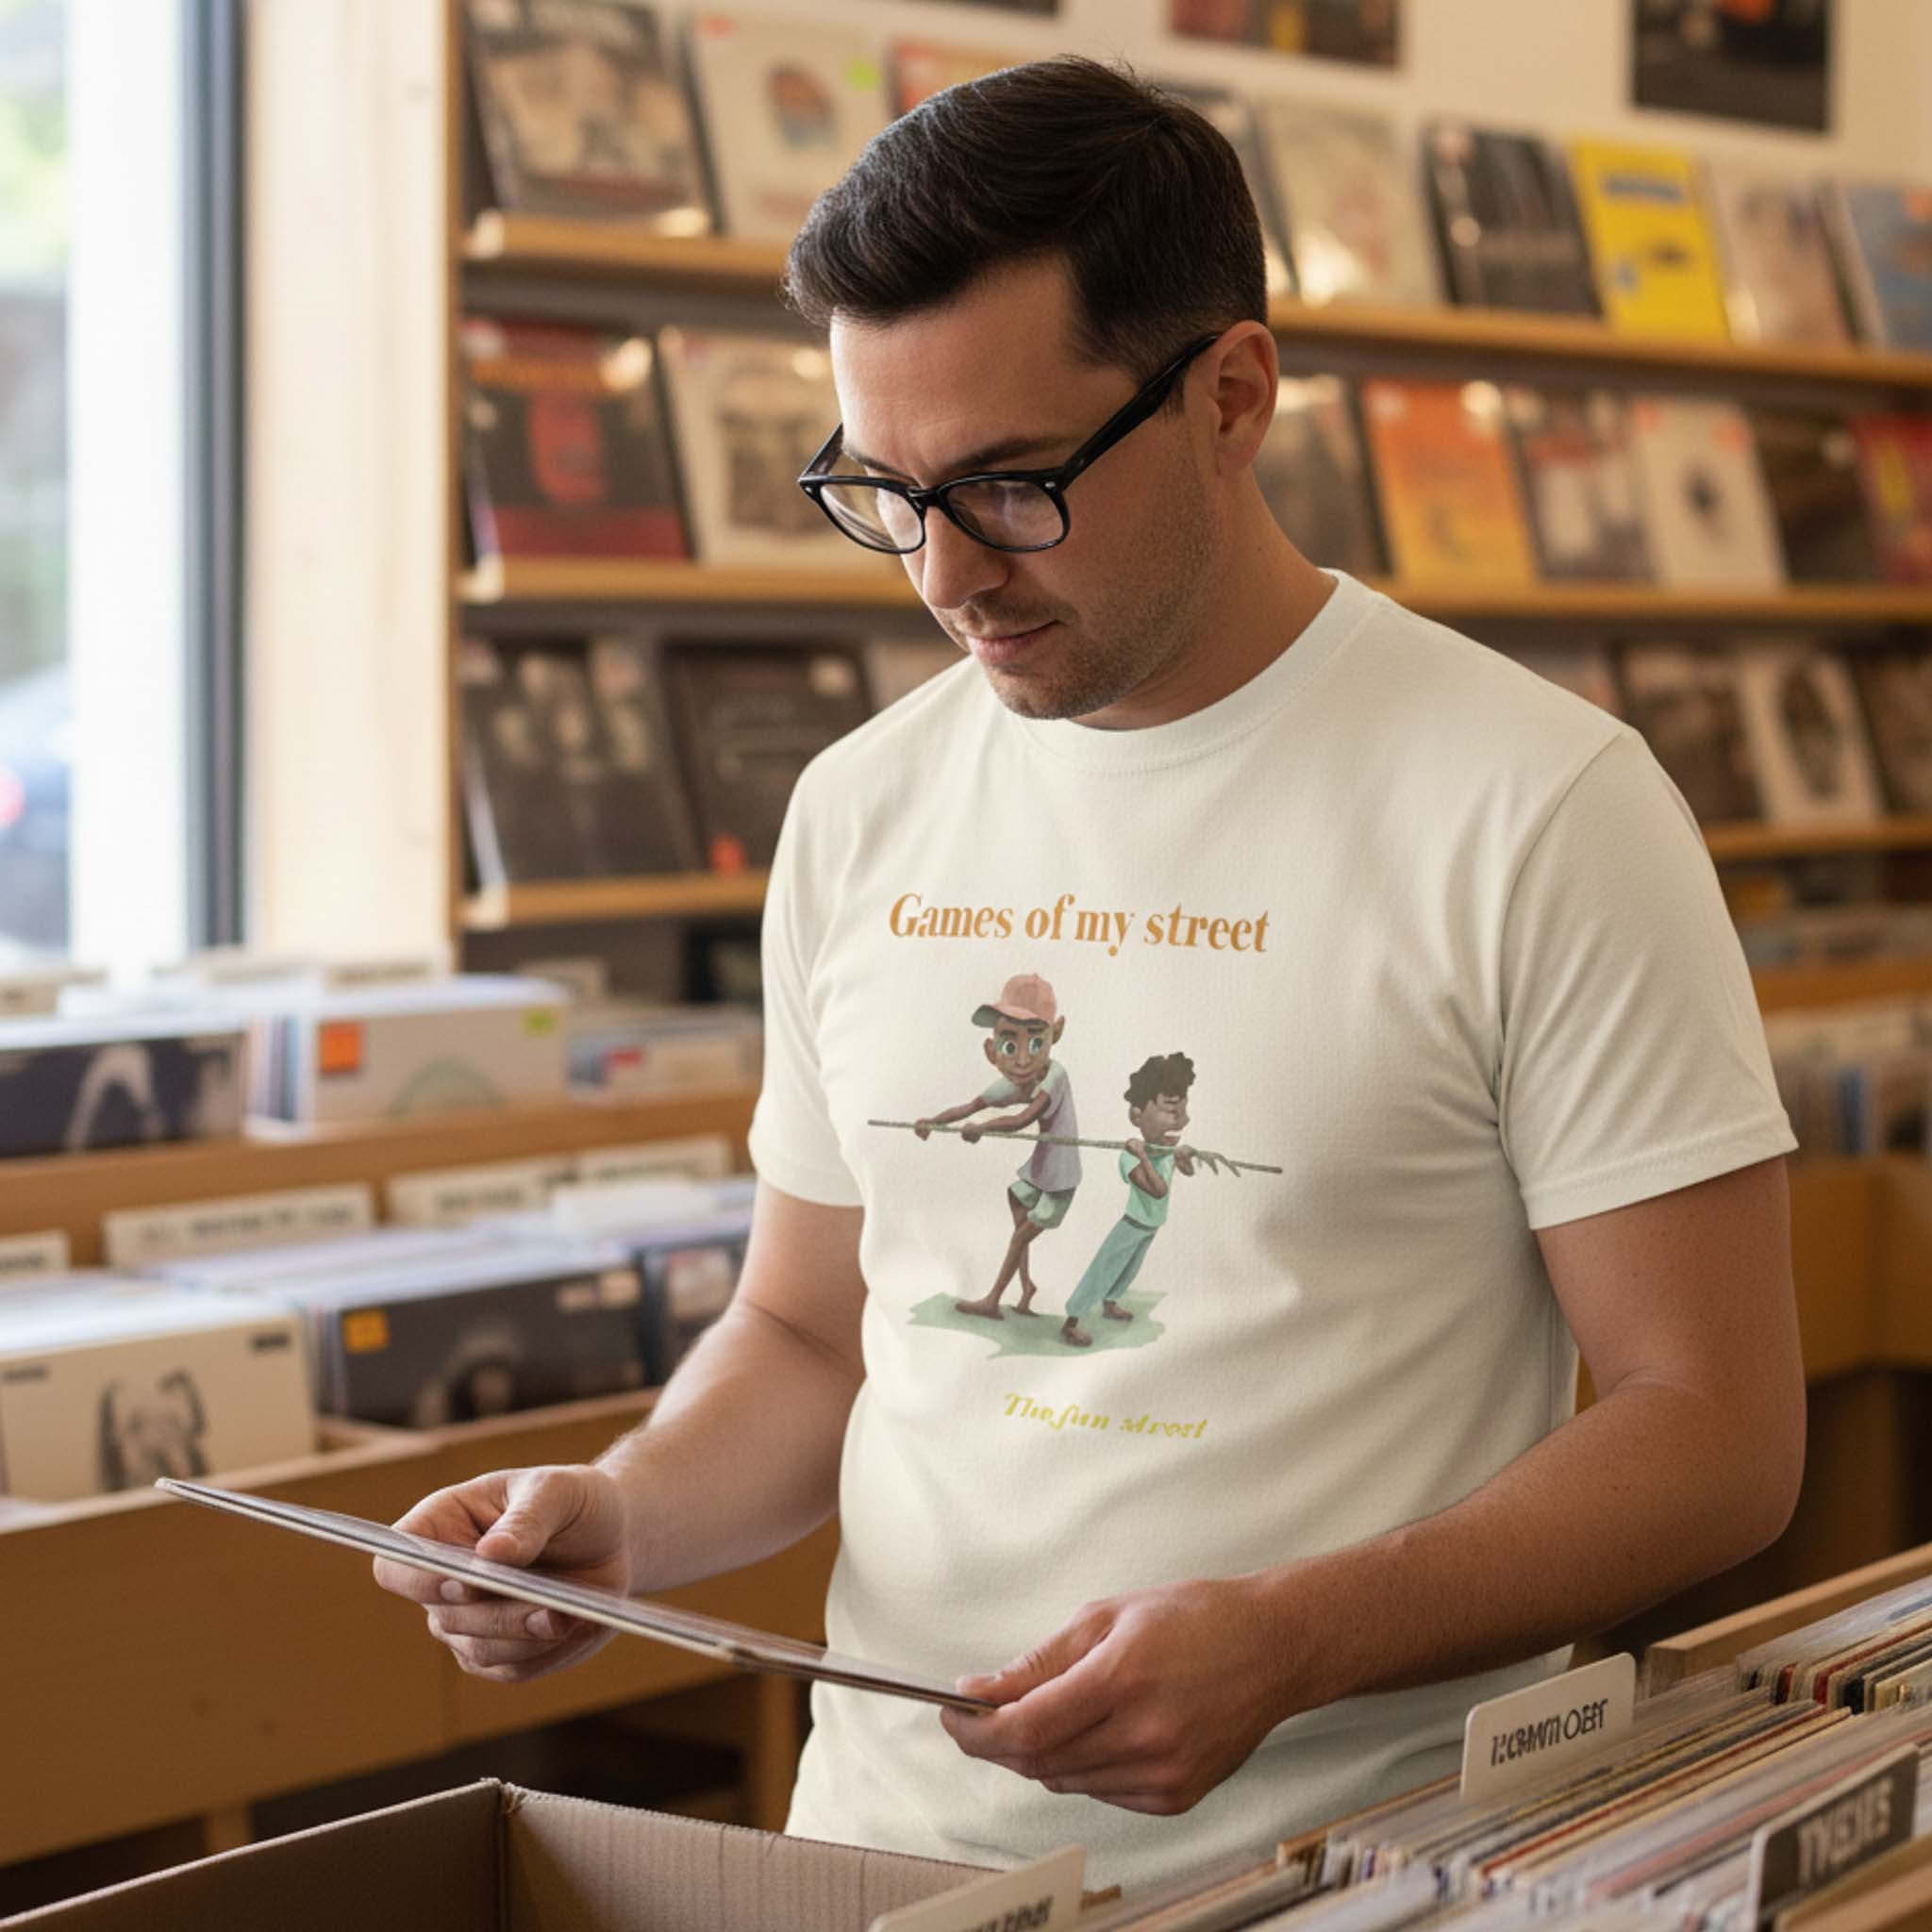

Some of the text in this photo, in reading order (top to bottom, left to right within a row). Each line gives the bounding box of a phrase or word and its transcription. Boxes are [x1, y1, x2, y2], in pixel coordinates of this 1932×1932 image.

[890, 892, 1270, 957] Games of my street
